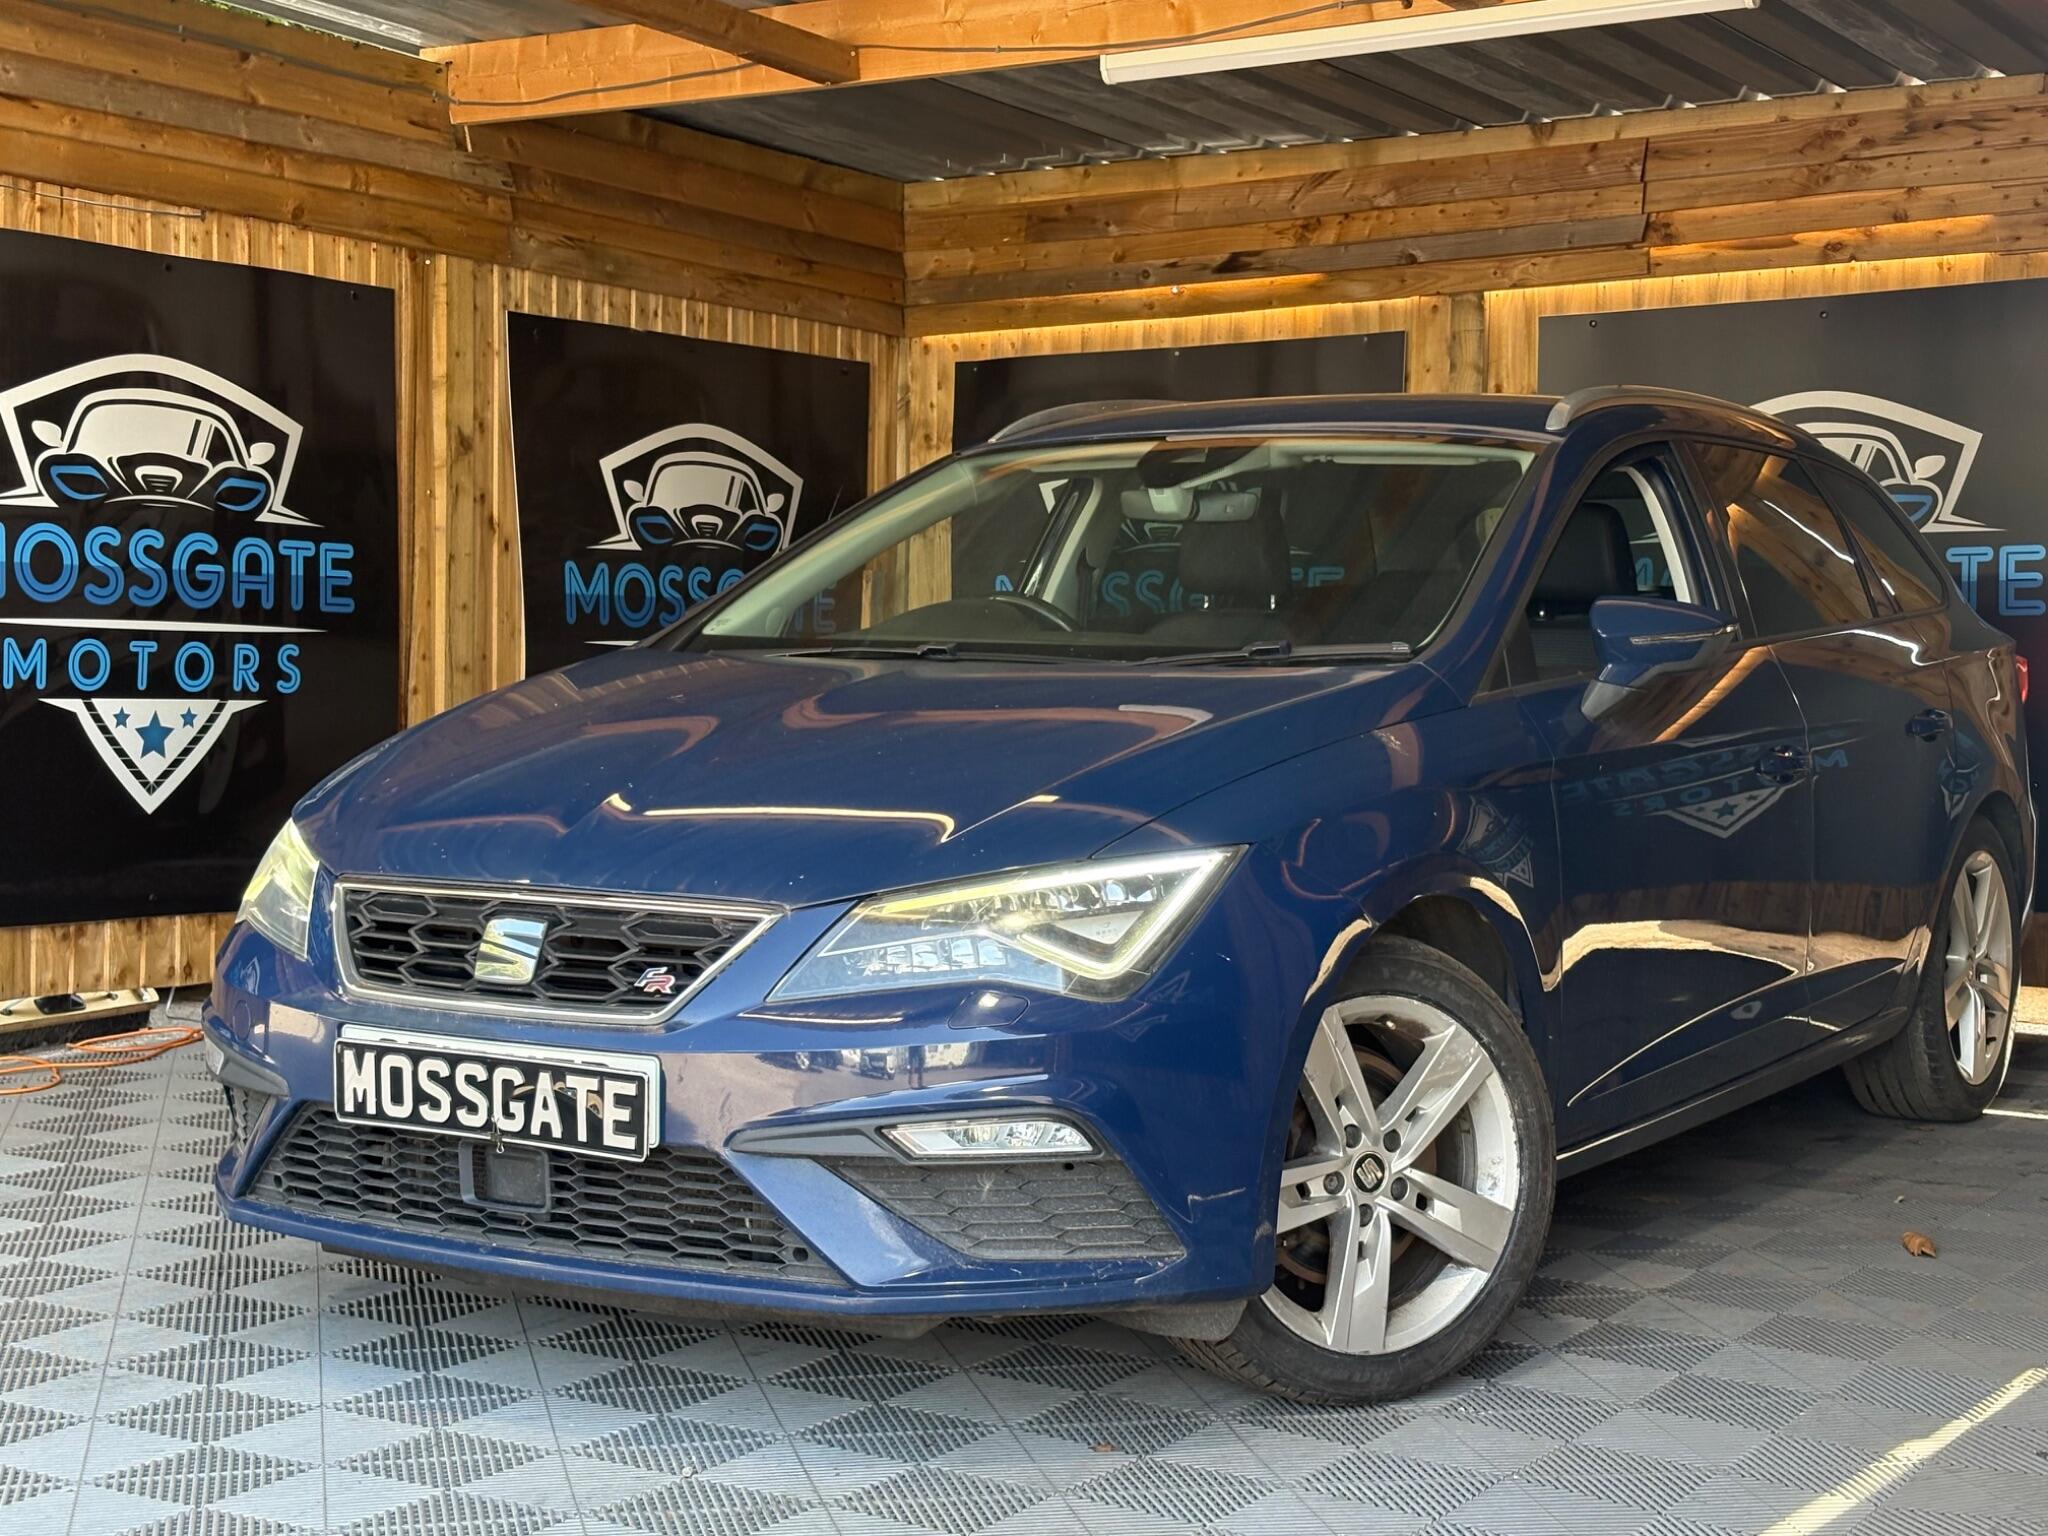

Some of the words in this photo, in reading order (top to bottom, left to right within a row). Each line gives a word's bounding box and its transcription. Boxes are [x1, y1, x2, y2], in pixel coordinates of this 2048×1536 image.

[0, 521, 355, 613] OSSGATE
[2, 637, 301, 694] MOTORS
[634, 966, 676, 994] FR
[343, 1049, 638, 1151] MOSSGATE
